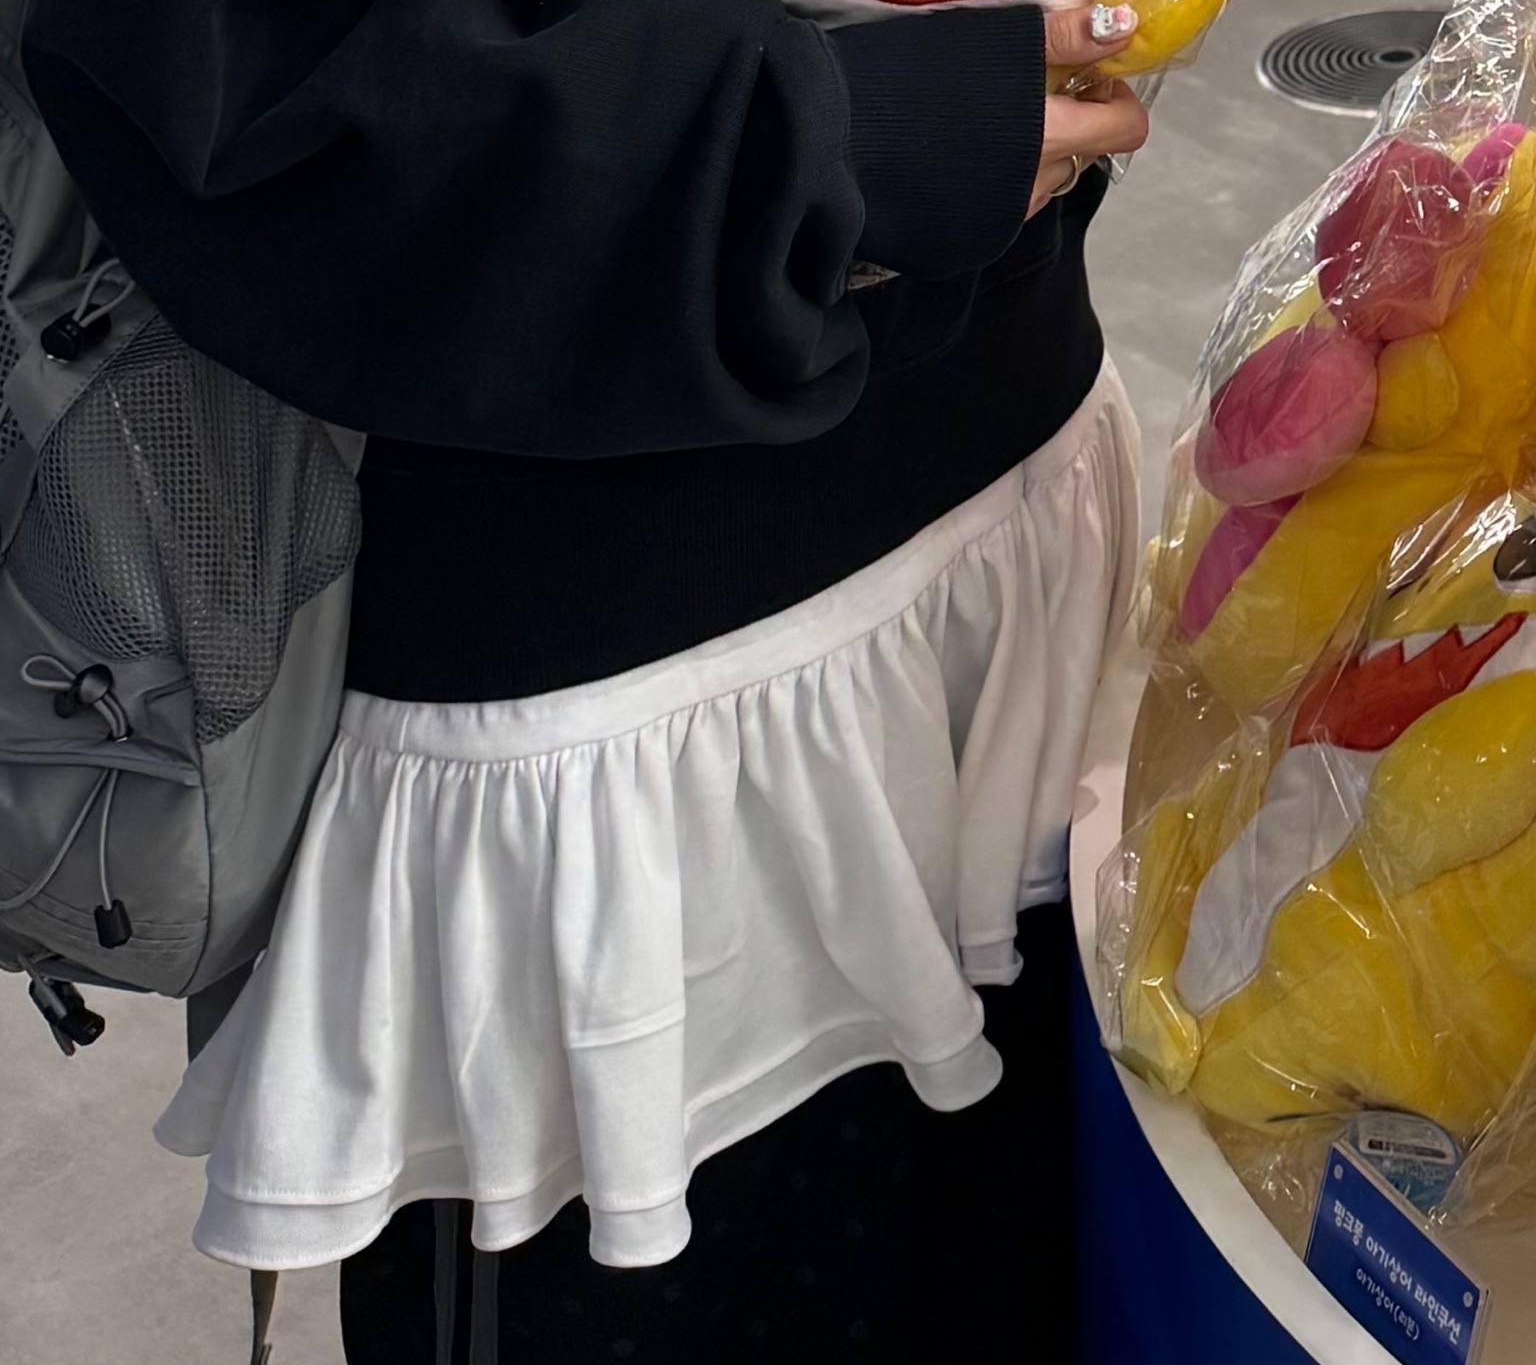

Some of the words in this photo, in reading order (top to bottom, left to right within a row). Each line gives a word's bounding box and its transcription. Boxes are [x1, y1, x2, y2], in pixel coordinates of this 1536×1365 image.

[1334, 1199, 1365, 1247] 핑크퐁
[1366, 1236, 1412, 1292] 아기상어
[1414, 1282, 1461, 1345] 라인쿠션
